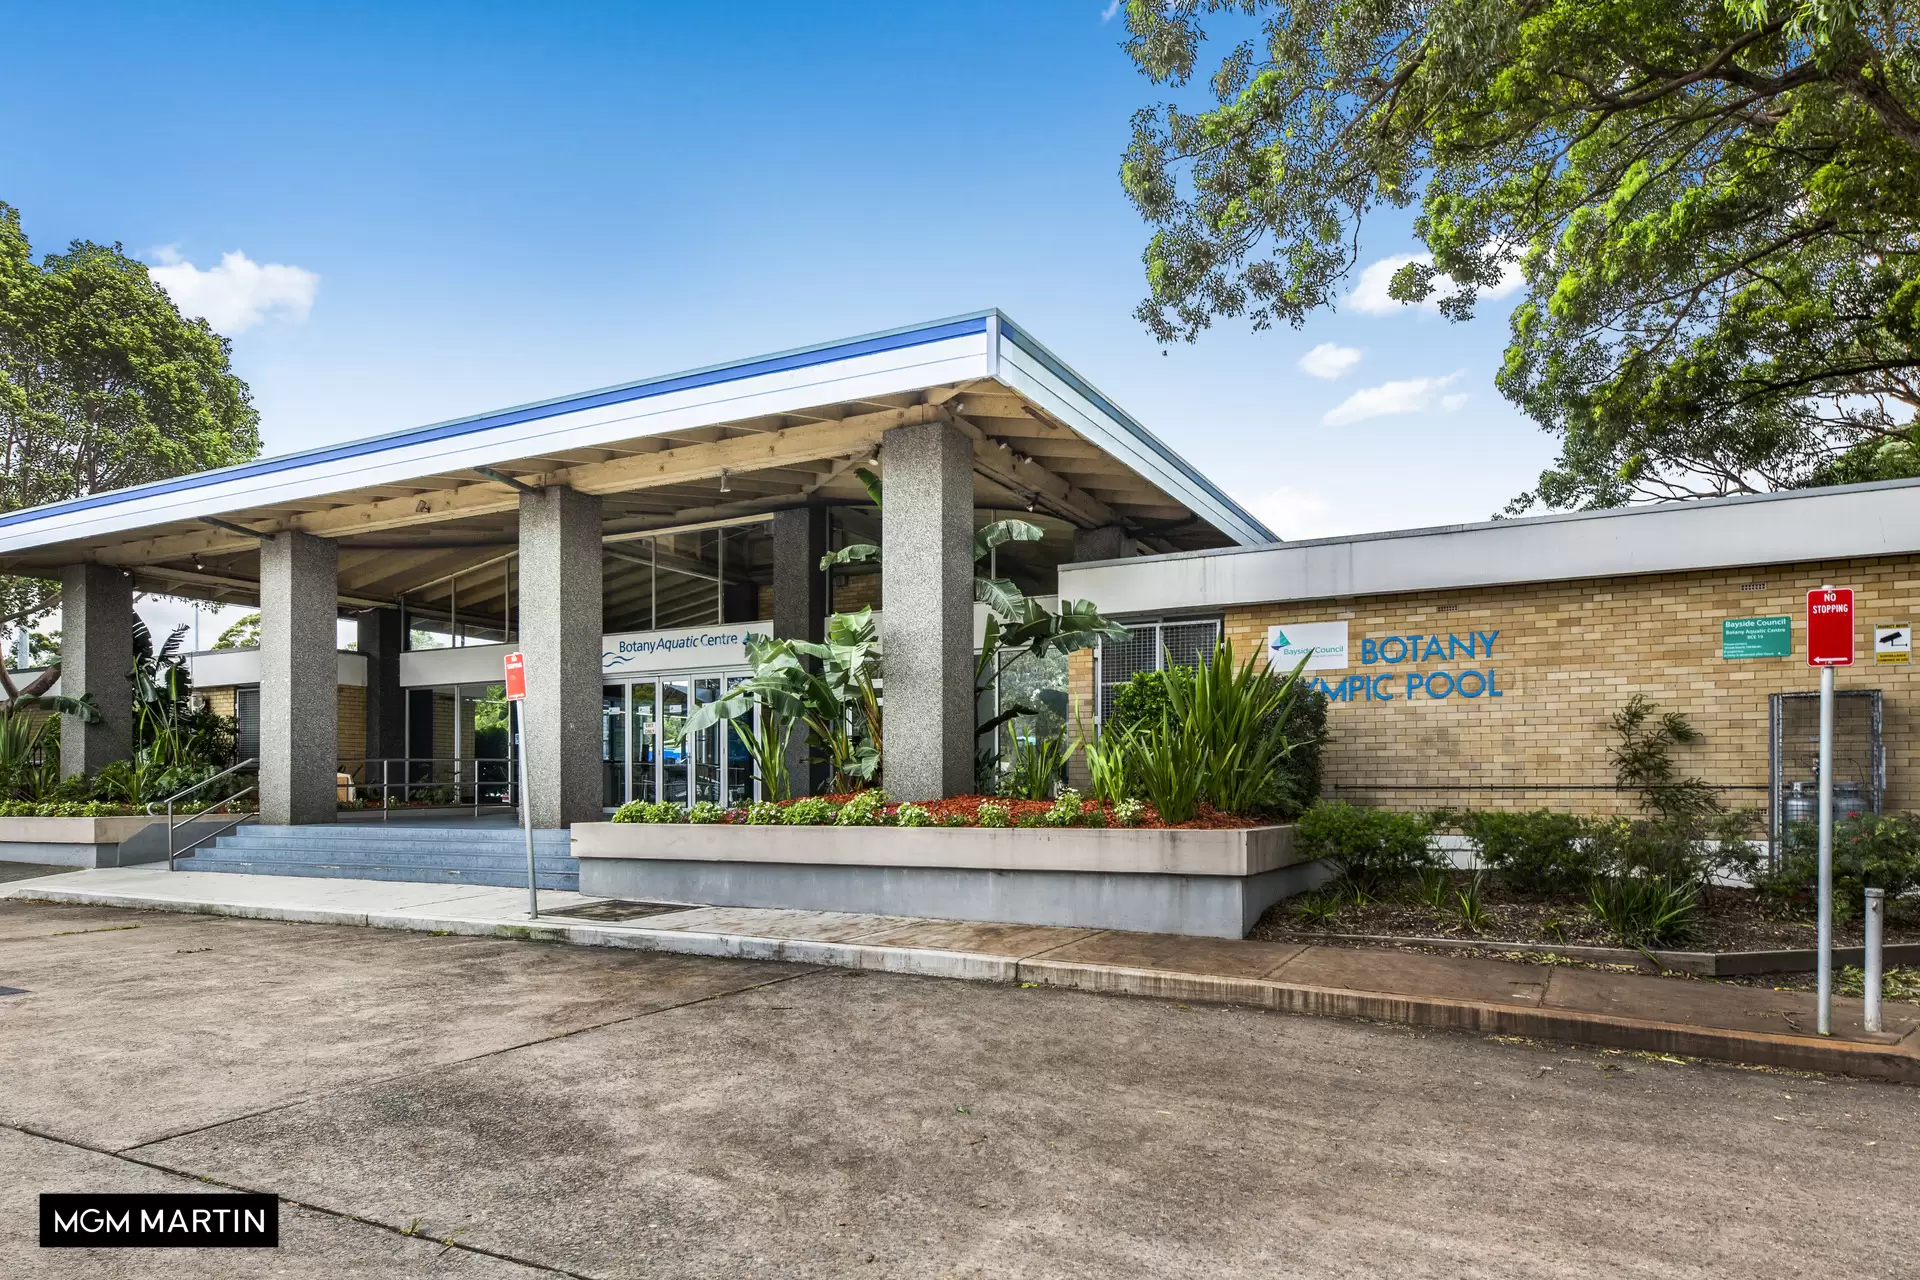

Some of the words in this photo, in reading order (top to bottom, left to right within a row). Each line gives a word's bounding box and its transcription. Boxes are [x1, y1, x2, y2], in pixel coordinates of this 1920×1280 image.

[1824, 593, 1836, 602] NO
[1812, 604, 1849, 614] STOPPING
[1725, 620, 1755, 629] Bayside
[1756, 618, 1786, 626] Council
[619, 640, 656, 654] Botany
[656, 635, 699, 652] Aquatic
[700, 633, 738, 646] Centre
[1361, 629, 1500, 664] BOTANY
[1315, 645, 1344, 654] Council
[1407, 669, 1503, 699] POOL
